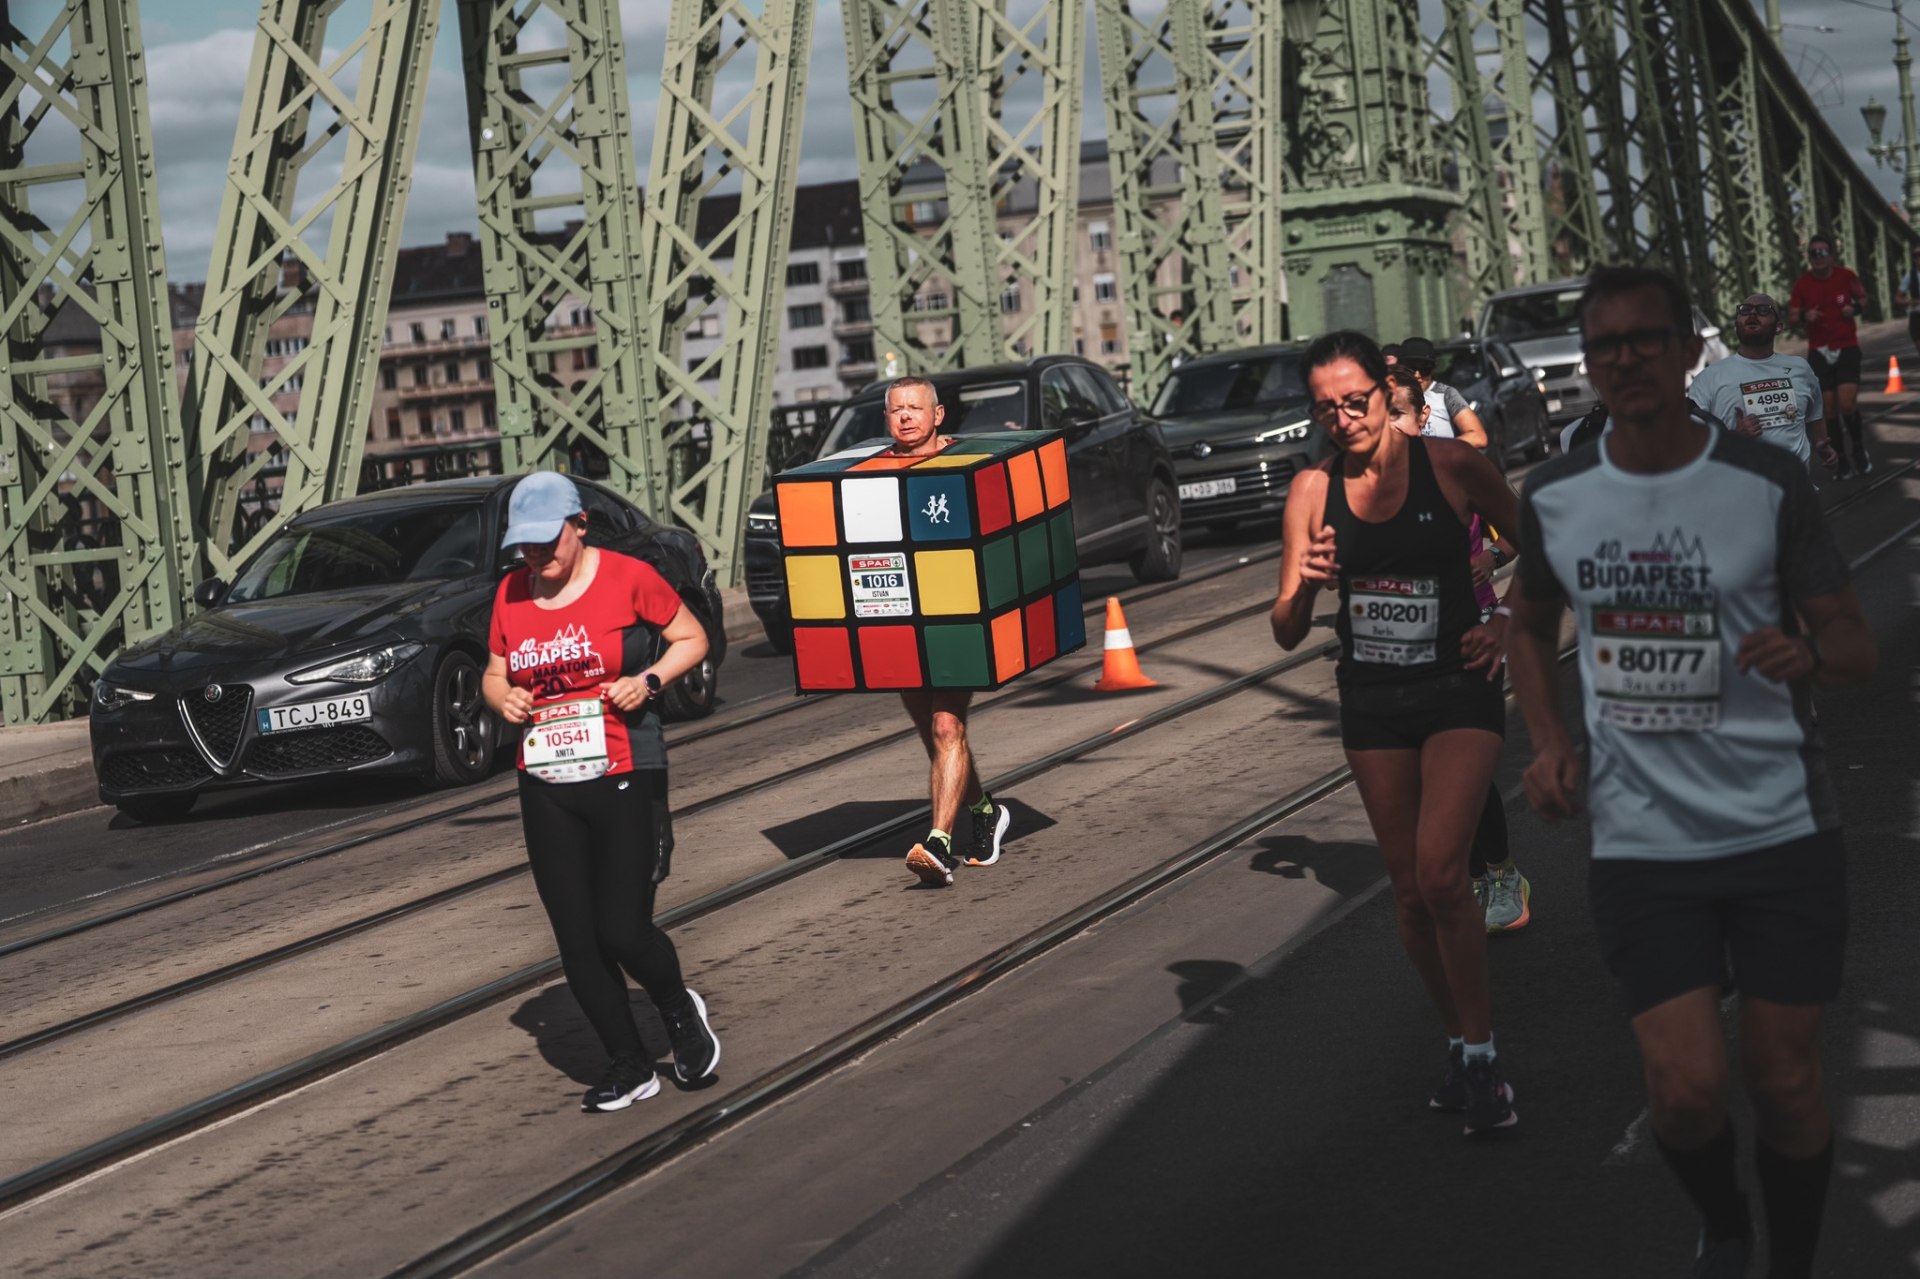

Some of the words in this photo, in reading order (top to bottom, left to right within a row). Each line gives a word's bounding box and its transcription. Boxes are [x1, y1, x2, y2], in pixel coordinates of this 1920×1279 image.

[1750, 382, 1778, 391] SPAR
[1757, 392, 1789, 405] 4999
[859, 560, 890, 568] SPAR
[867, 574, 898, 588] 1016
[1577, 558, 1712, 591] BUDAPEST
[1366, 581, 1412, 592] SPAR
[1367, 601, 1427, 623] 80201
[1612, 616, 1683, 630] SPAR
[510, 641, 592, 672] BUDAPEST
[1618, 646, 1705, 675] 80177
[584, 667, 605, 678] 2025
[273, 699, 365, 728] TCJ-849
[540, 705, 579, 721] SPAR
[528, 738, 535, 747] 6
[545, 729, 589, 748] 10541
[555, 748, 575, 759] ANITA
